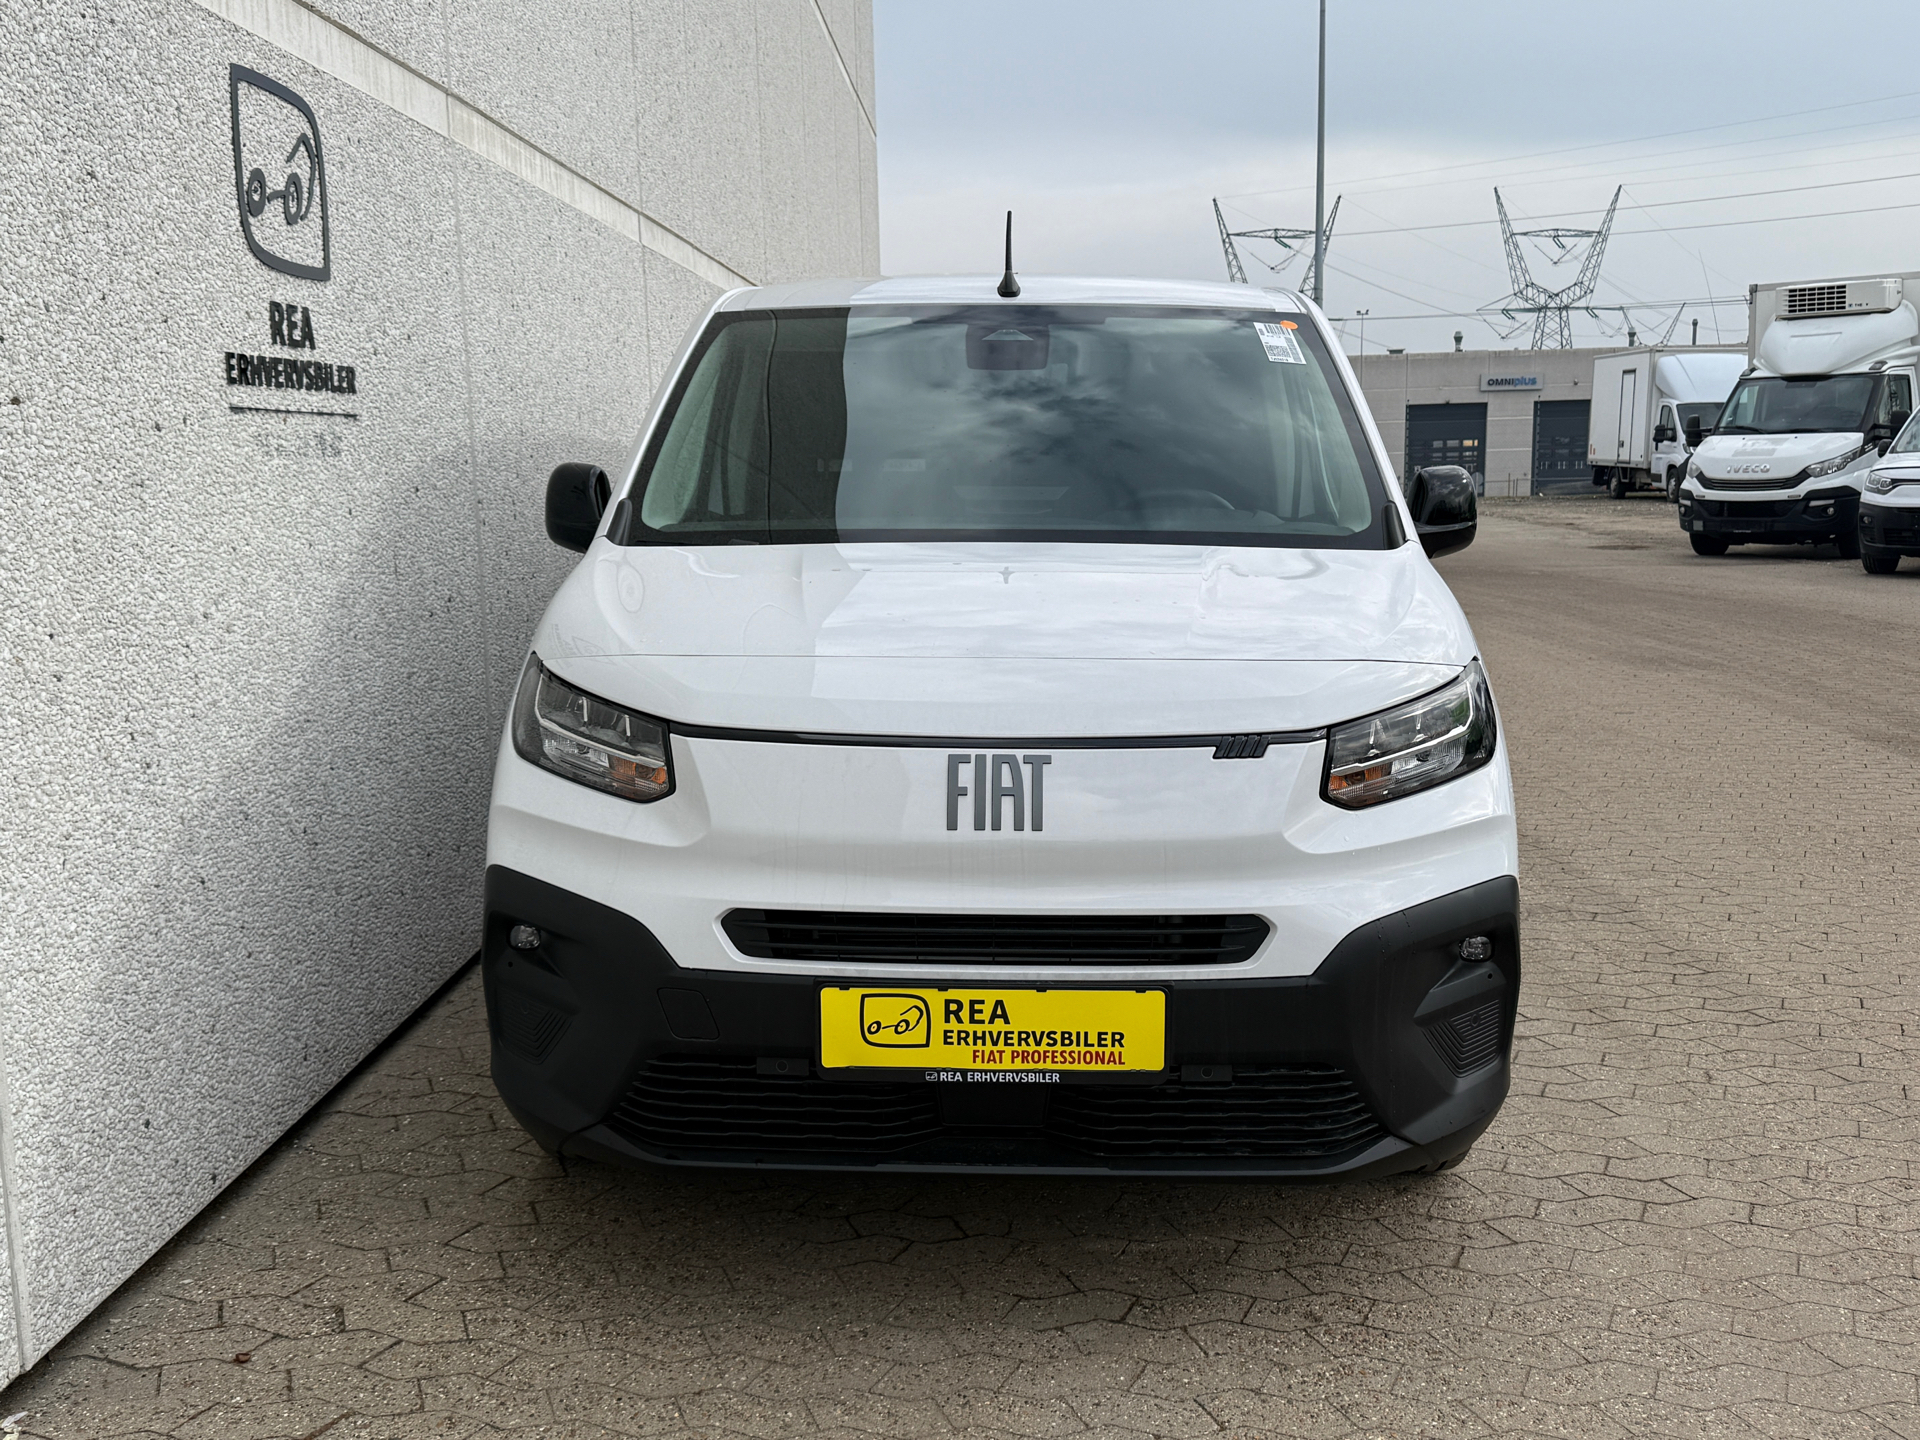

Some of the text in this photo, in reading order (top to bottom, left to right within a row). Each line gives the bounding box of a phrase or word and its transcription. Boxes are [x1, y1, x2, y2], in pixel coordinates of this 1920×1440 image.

[269, 300, 316, 350] REA
[225, 351, 357, 394] ERHVERVSBILER
[1726, 463, 1770, 473] IVECO
[946, 753, 1053, 832] FIAT
[943, 998, 1011, 1025] REA
[942, 1029, 1125, 1048] ERHVERVSBILER
[972, 1049, 1126, 1066] FIAT PROFESSIONAL
[939, 1071, 1060, 1084] REA ERHVERVSBILER
